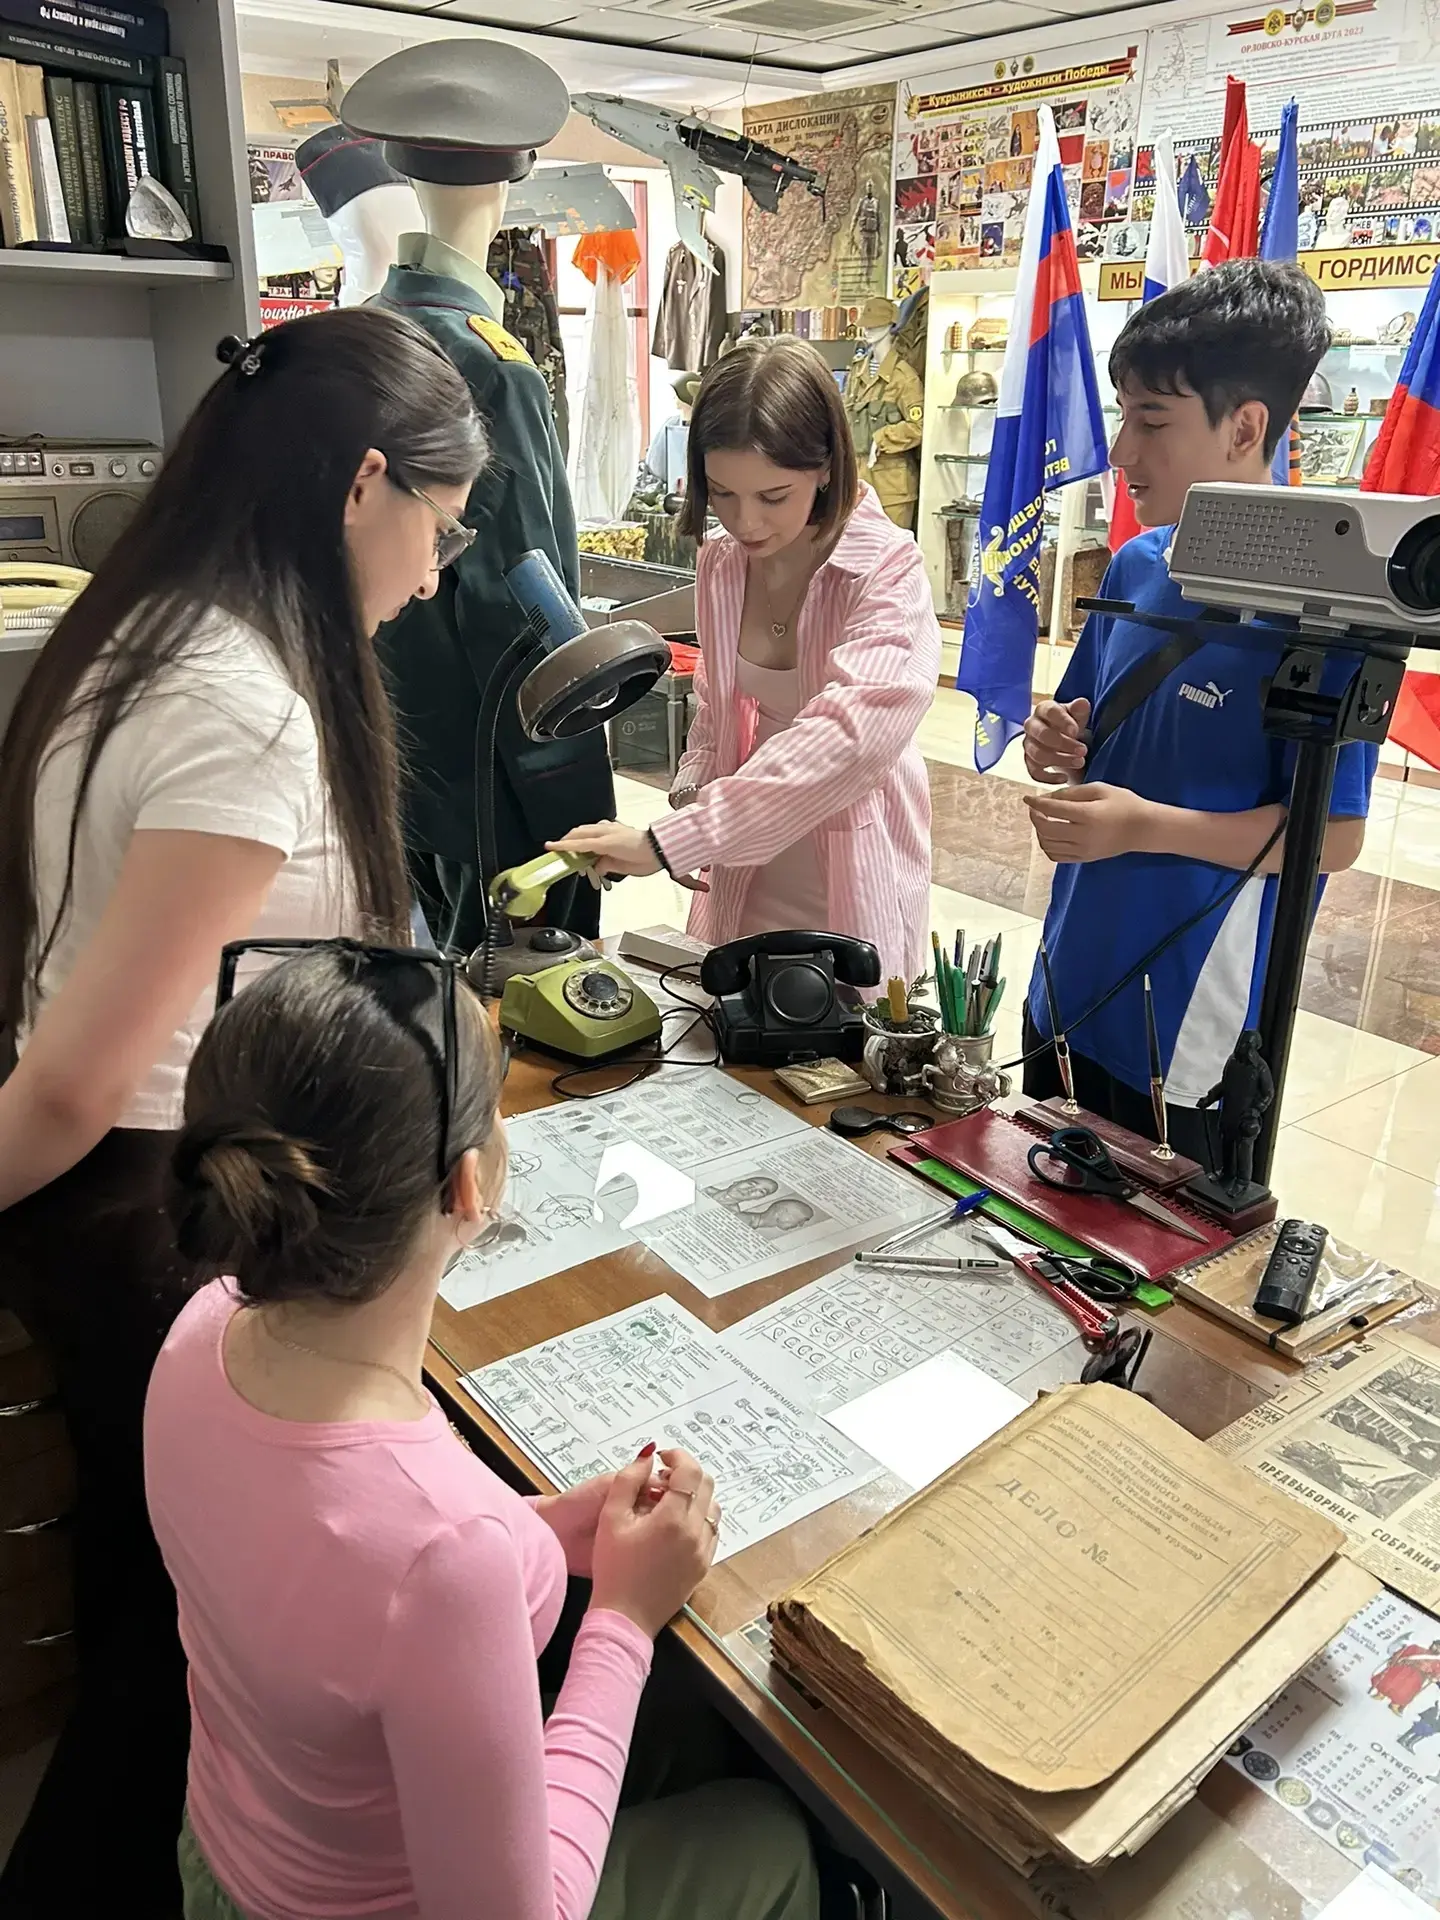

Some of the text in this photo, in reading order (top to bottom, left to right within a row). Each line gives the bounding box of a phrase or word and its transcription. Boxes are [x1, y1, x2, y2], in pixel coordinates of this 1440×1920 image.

[40, 6, 51, 20] РФ
[54, 44, 75, 56] ПРАВО
[1241, 26, 1364, 54] ОРЛОВСКО-КУРСКАЯ ДУГА 2023
[76, 50, 131, 68] МЕЖДУНАРОДНОЕ
[166, 72, 178, 105] СОСТОЯНИЯ
[175, 73, 184, 101] ПОМОЩЬ
[929, 87, 992, 106] Кукрыниксы
[1002, 74, 1062, 95] художники
[1066, 64, 1110, 82] Победы
[1106, 88, 1120, 97] 1945
[79, 102, 90, 145] КОДЕКС
[176, 101, 188, 143] МЕДИЦИНСКАЯ
[746, 113, 840, 136] КАРТА ДИСЛОКАЦИИ
[774, 136, 790, 144] ВОЙСК
[806, 128, 839, 139] ТЕРРИТОРИИ
[56, 95, 74, 217] УГОЛОВНЫЙ КОДЕКС
[64, 96, 82, 217] РОССИЙСКОЙ ФЕДЕРАЦИИ
[119, 98, 138, 194] РАЖДАНСКОМУ КОДЕКСУ РФ
[138, 149, 150, 176] ретьей.
[180, 144, 191, 177] ЭКСТРЕННАЯ
[264, 151, 294, 160] ПРАВО
[9, 183, 23, 242] ОММЕНТАРИЙ
[1110, 270, 1142, 290] МЫ
[1178, 683, 1218, 709] PUMA
[715, 1345, 804, 1417] ТАТУИРОВКИ ТЮРЕМНЫЕ
[802, 1454, 825, 1474] ОМУТ
[1053, 1414, 1095, 1439] ОХРАНЫ
[1097, 1439, 1180, 1502] ОБЩЕСТВЕННОГО
[1183, 1503, 1232, 1536] ПОРЯДКА
[1117, 1441, 1181, 1490] УПРАВЛЕНИЕ
[1026, 1435, 1084, 1474] Следственный
[1165, 1534, 1203, 1561] группа)
[996, 1478, 1109, 1563] ДЕЛО №
[1258, 1462, 1360, 1523] ПРЕДВЫБОРНЫЕ
[1371, 1528, 1440, 1572] СОБРАНИЯ
[1370, 1741, 1425, 1785] Октябрь
